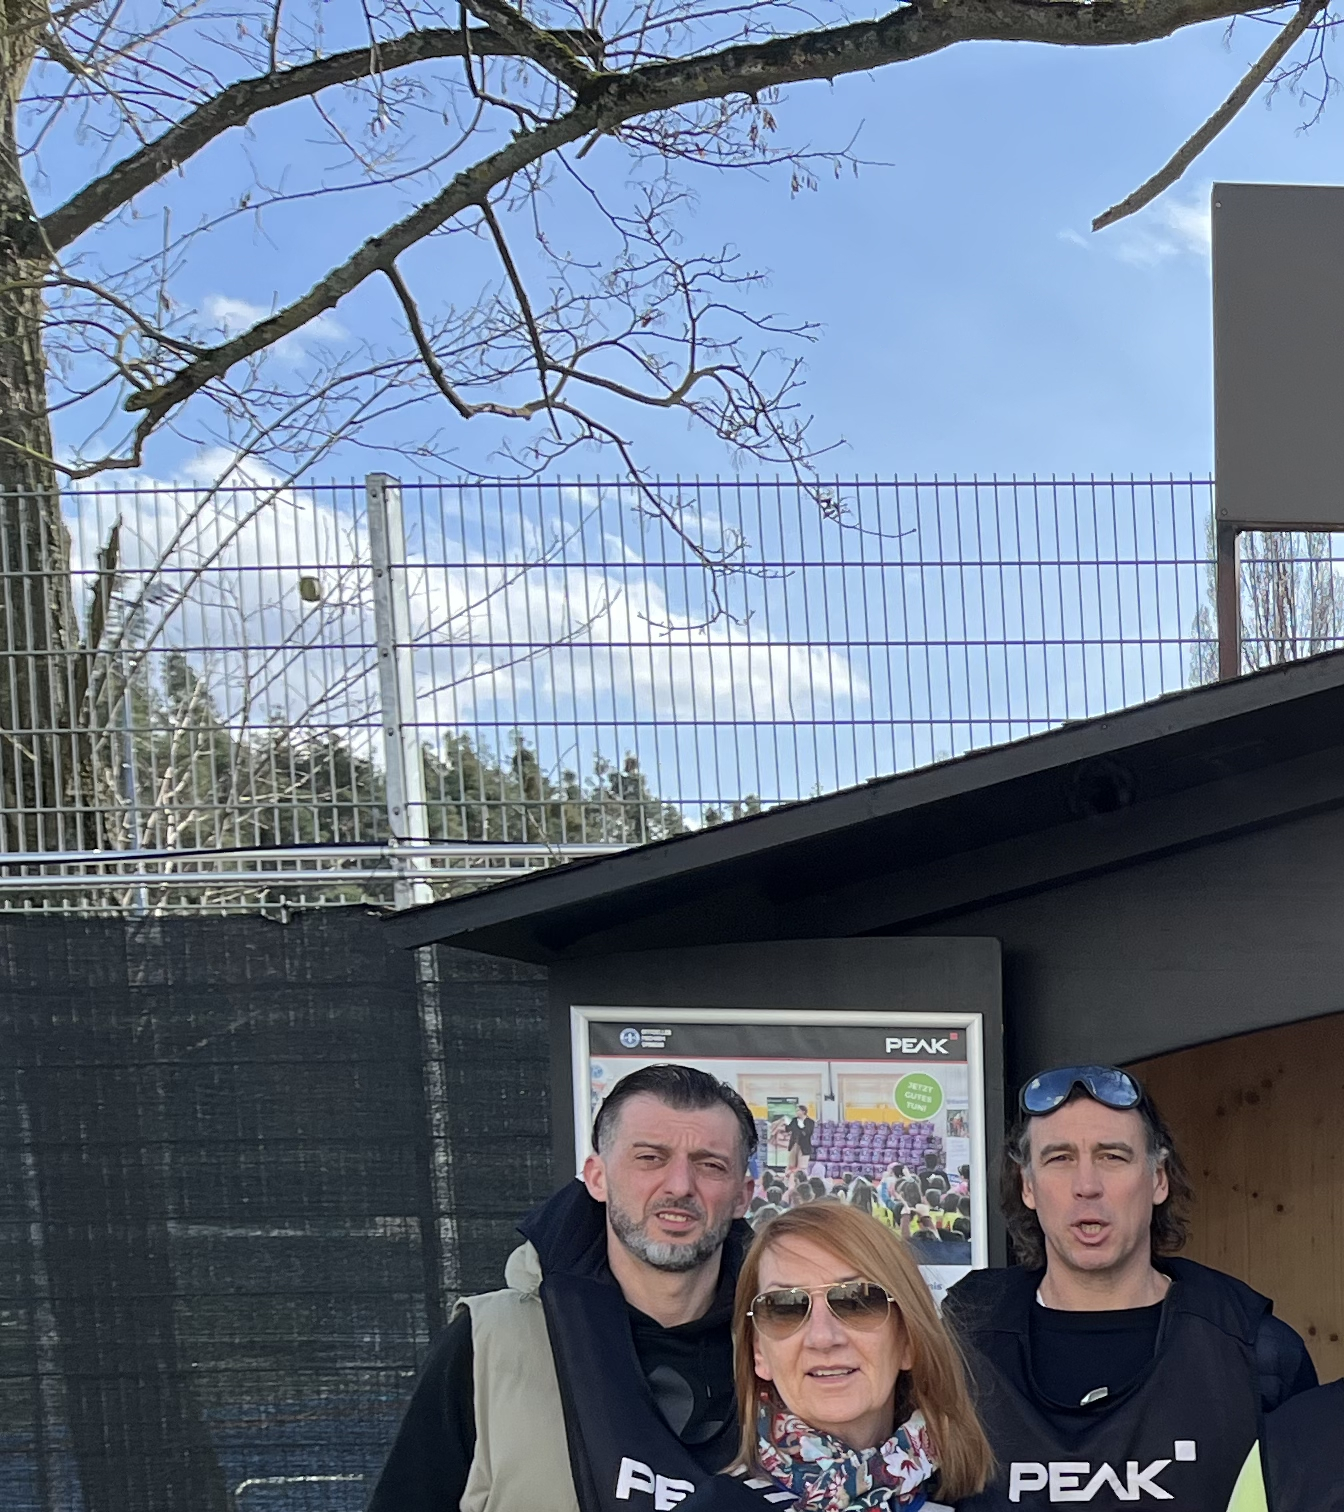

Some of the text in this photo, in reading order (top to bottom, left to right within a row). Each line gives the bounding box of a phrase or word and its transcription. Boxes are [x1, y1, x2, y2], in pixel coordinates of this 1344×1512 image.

[885, 1037, 950, 1055] PEAK
[908, 1081, 934, 1094] JETZT
[904, 1091, 933, 1103] GUTES
[615, 1456, 696, 1512] PE
[1008, 1459, 1175, 1503] PEAK
